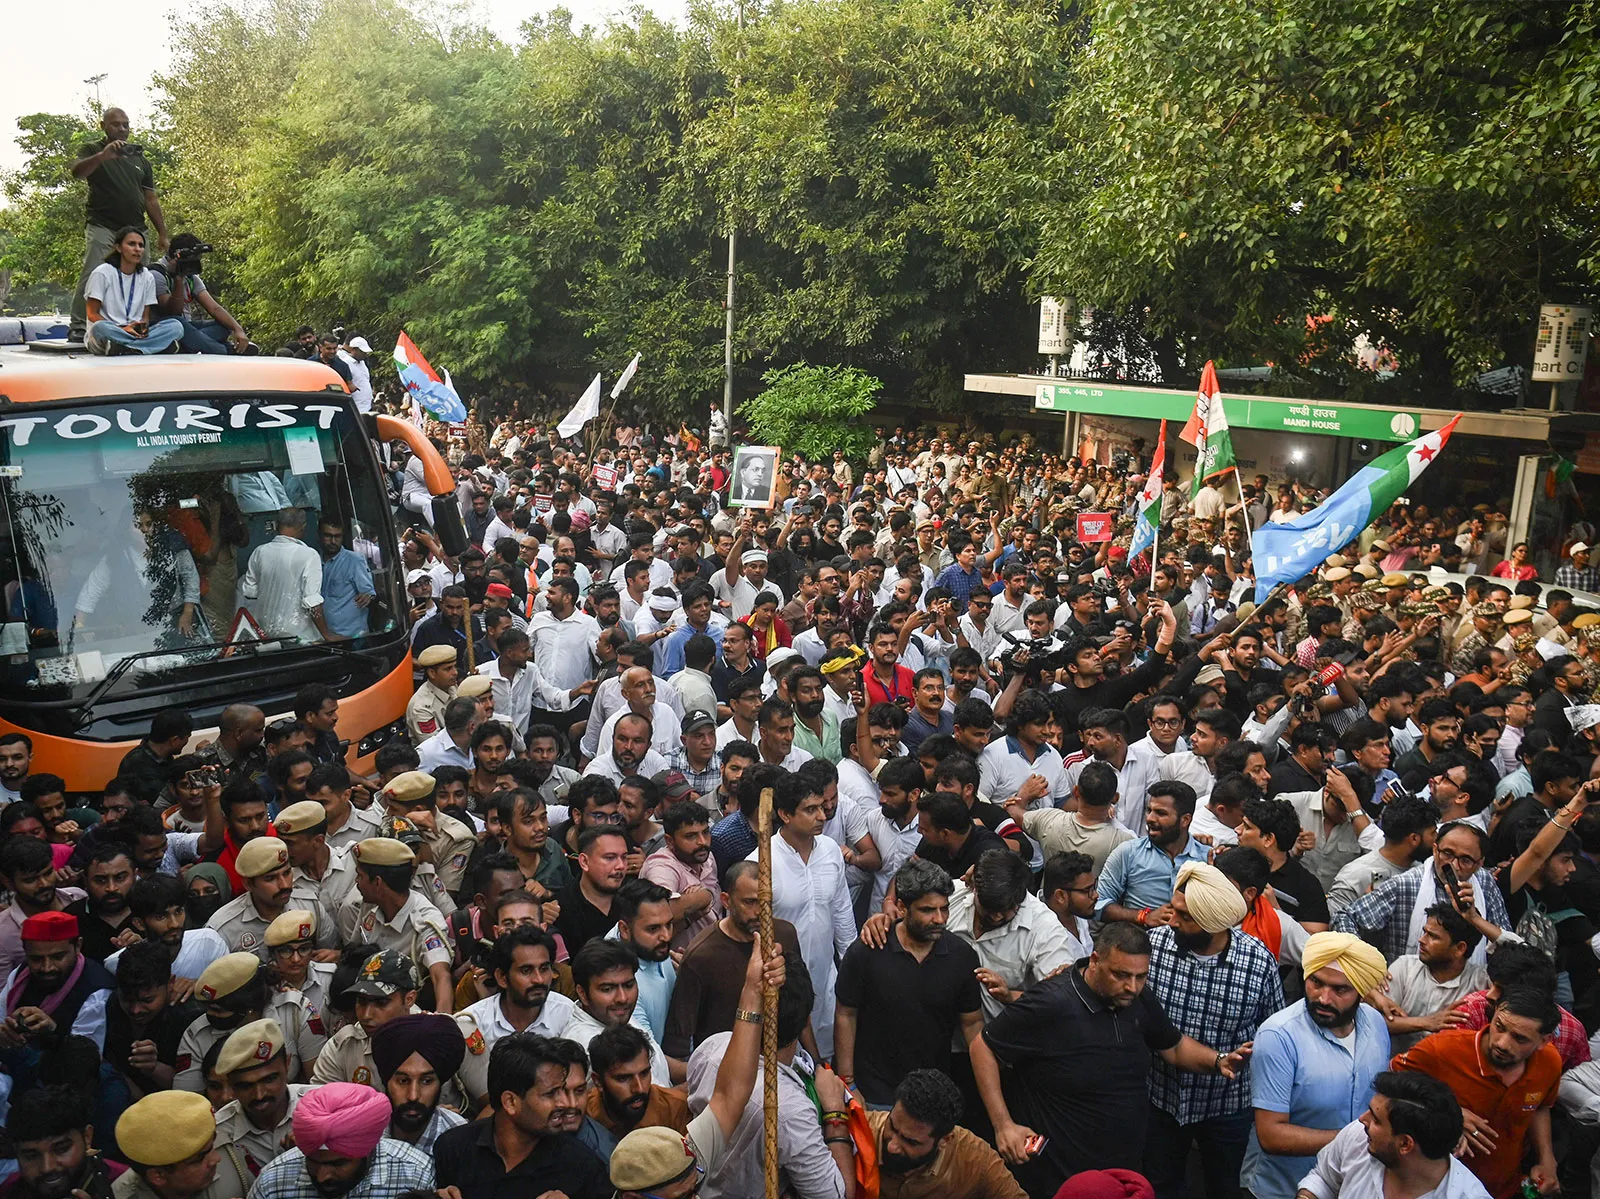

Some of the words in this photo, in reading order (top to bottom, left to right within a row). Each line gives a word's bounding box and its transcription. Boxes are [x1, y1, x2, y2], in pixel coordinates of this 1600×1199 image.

[1041, 339, 1061, 347] mart
[1534, 361, 1561, 373] mart
[1090, 389, 1103, 397] LTD
[1289, 404, 1310, 416] मण्डी
[1312, 408, 1337, 418] हाउस
[0, 403, 343, 446] TOURIST
[1283, 417, 1310, 427] MANDI
[1311, 420, 1341, 431] HOUSE
[137, 436, 150, 447] ALL
[149, 435, 169, 446] INDIA
[168, 433, 197, 445] TOURIST
[197, 432, 222, 444] PERMIT
